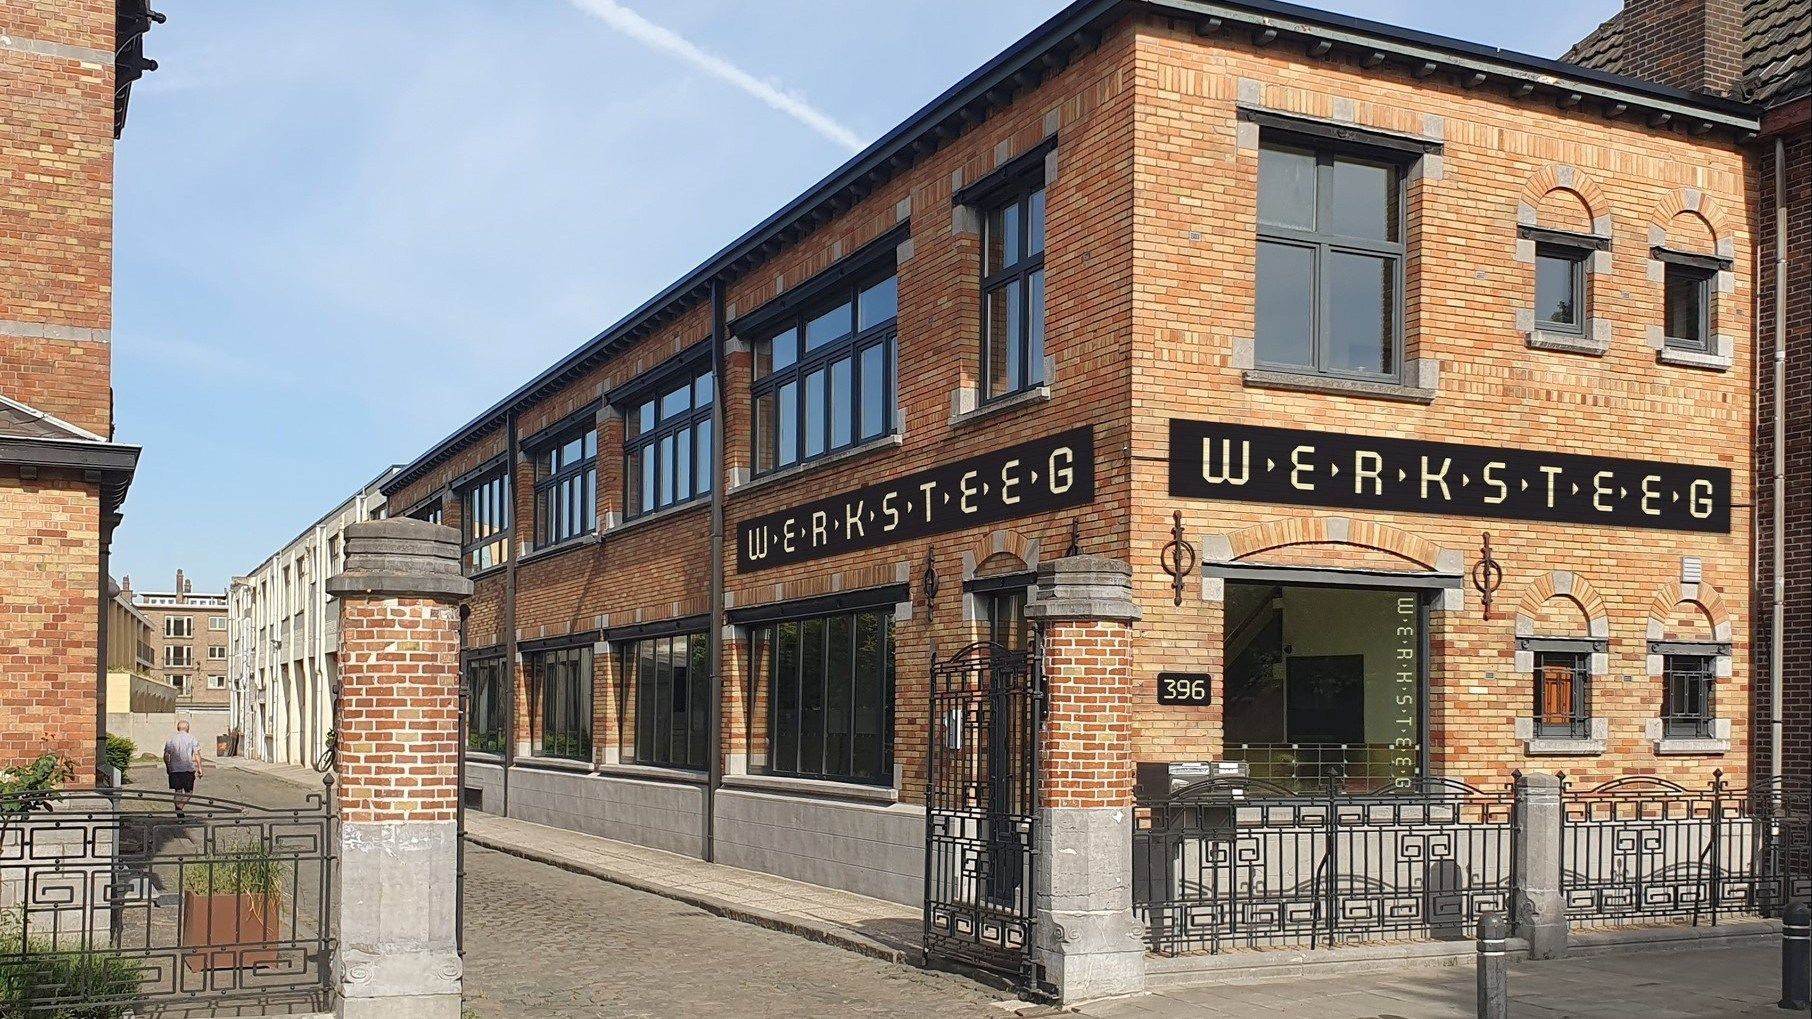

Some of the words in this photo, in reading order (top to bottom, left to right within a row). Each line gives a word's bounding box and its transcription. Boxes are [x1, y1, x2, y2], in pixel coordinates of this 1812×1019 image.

[748, 446, 1074, 561] WERKSTEEG
[1202, 436, 1713, 519] WERKSTEEG
[1163, 679, 1206, 700] 396
[1395, 597, 1414, 788] WERKSTEEG
